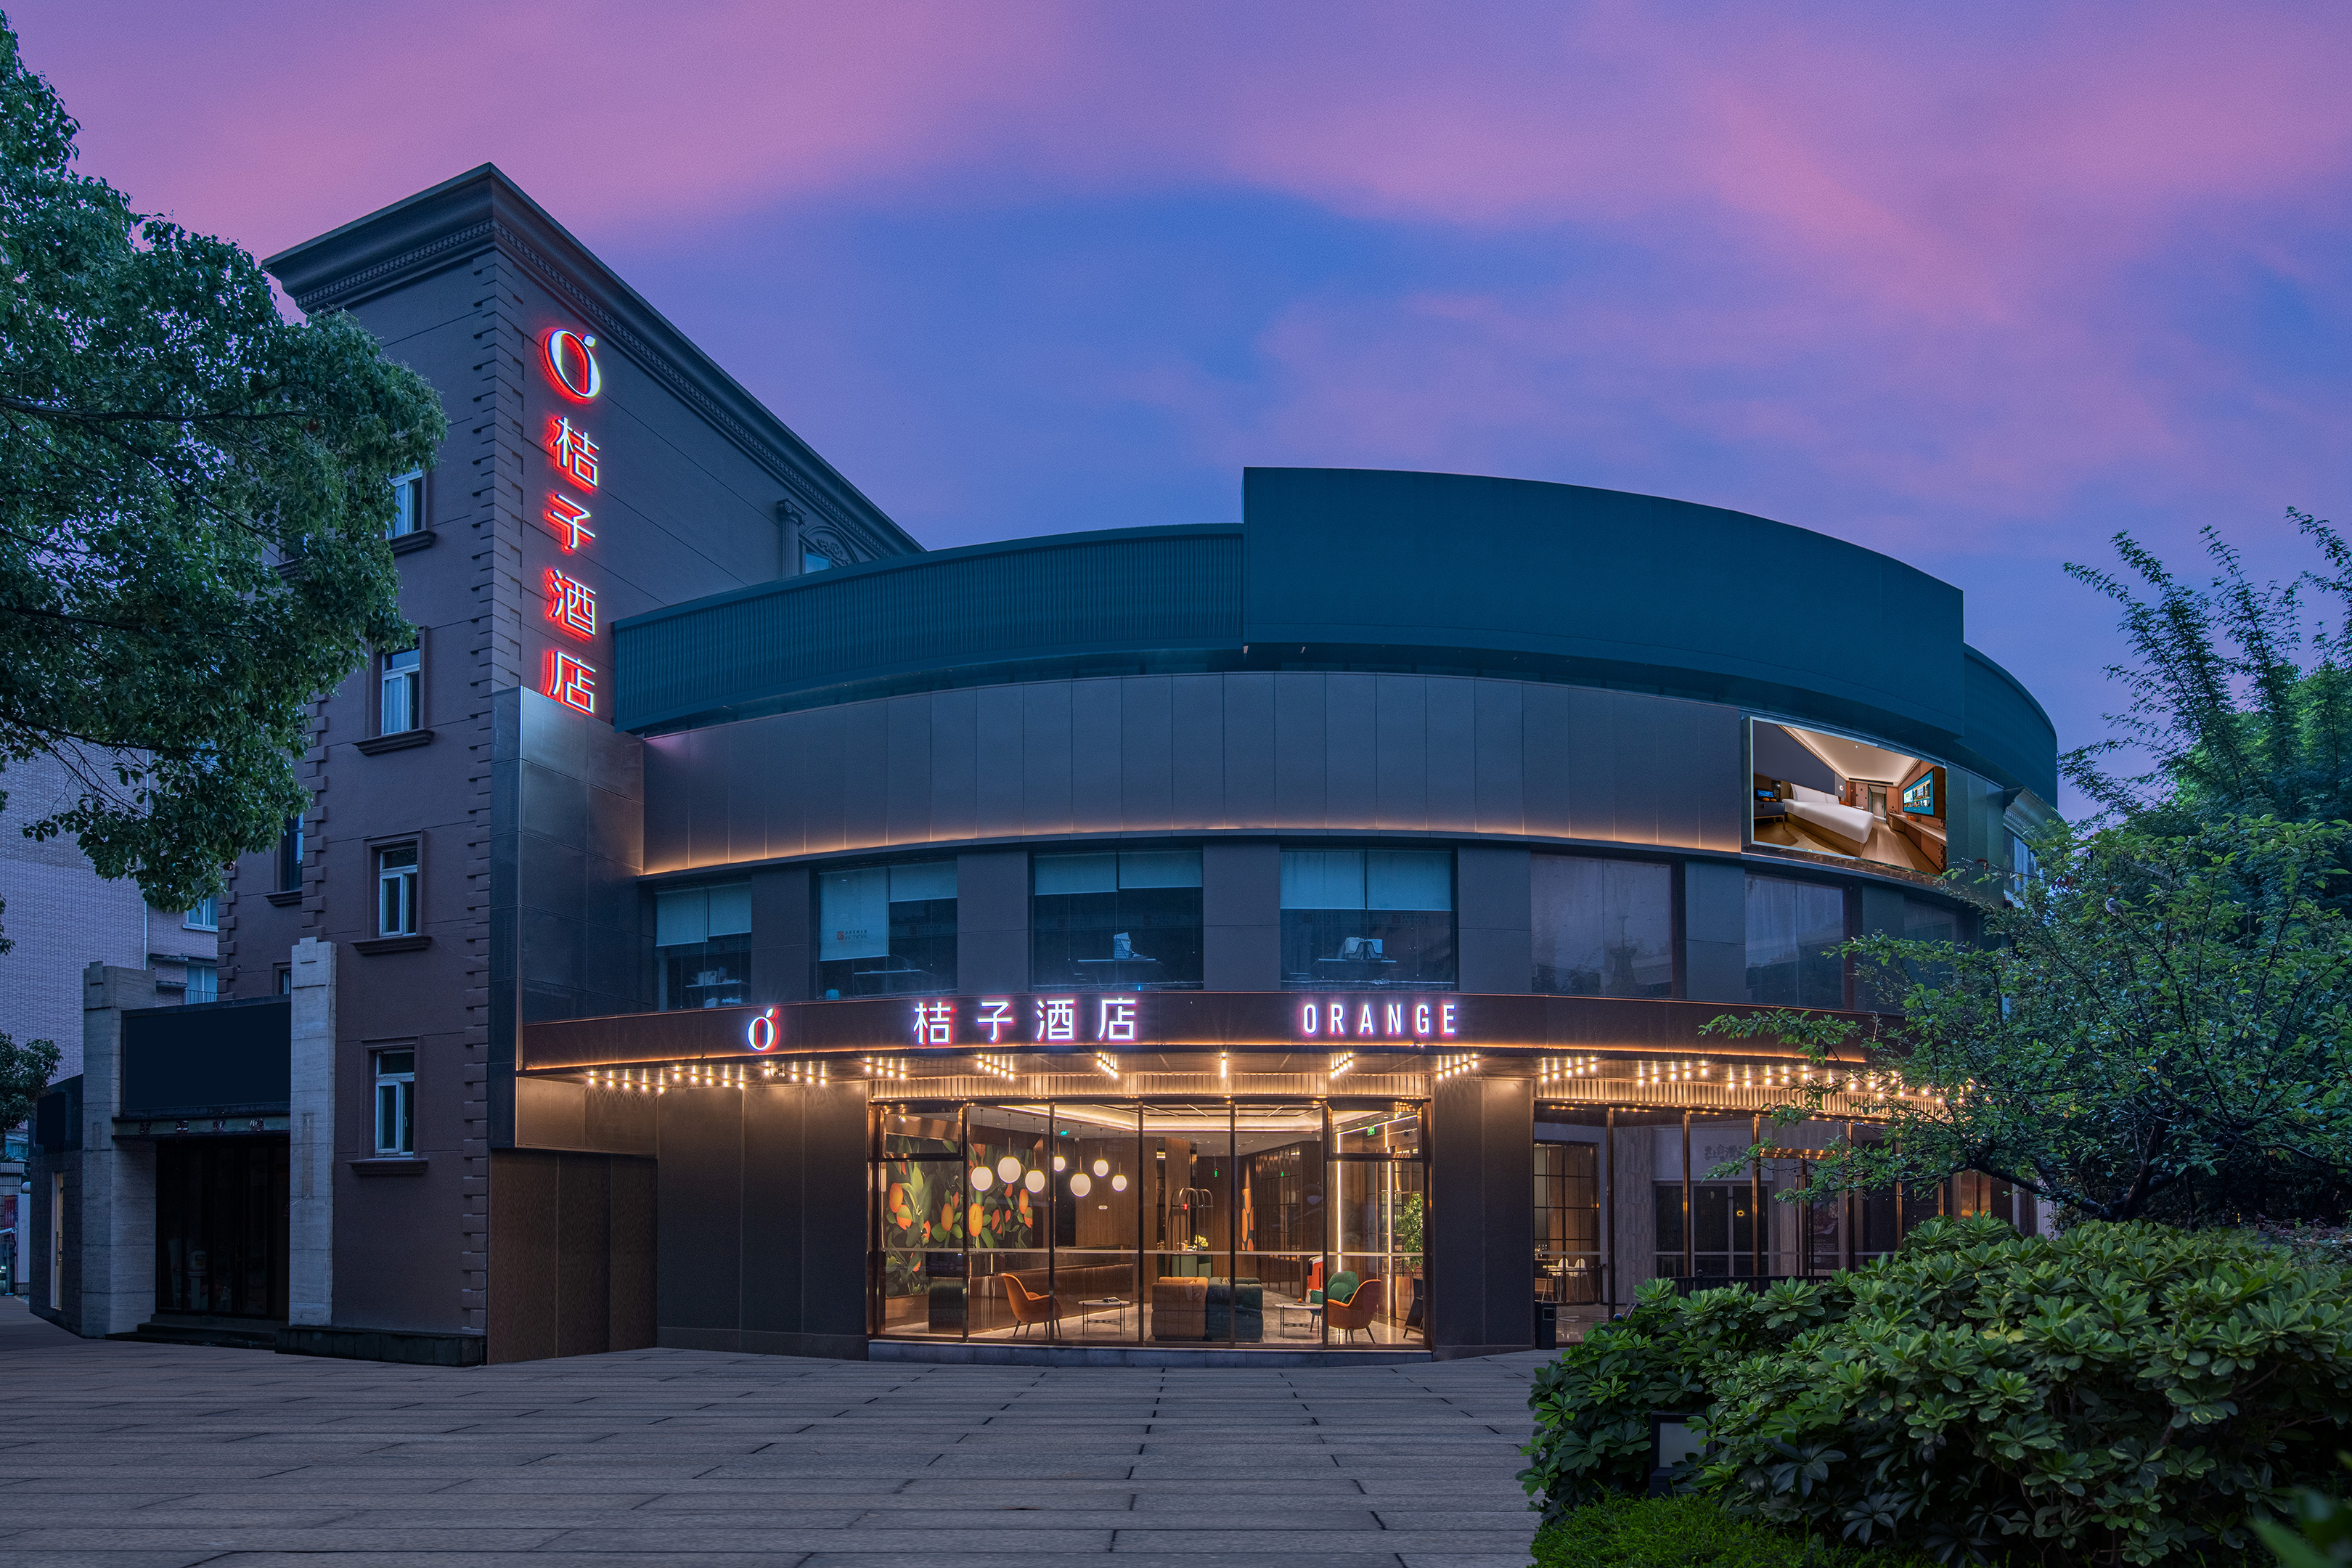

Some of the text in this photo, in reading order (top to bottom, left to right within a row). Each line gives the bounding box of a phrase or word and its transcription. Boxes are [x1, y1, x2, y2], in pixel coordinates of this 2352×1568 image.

[549, 417, 599, 714] 桔子酒店
[913, 997, 1136, 1045] 桔子酒店
[1302, 1003, 1456, 1034] ORANGE
